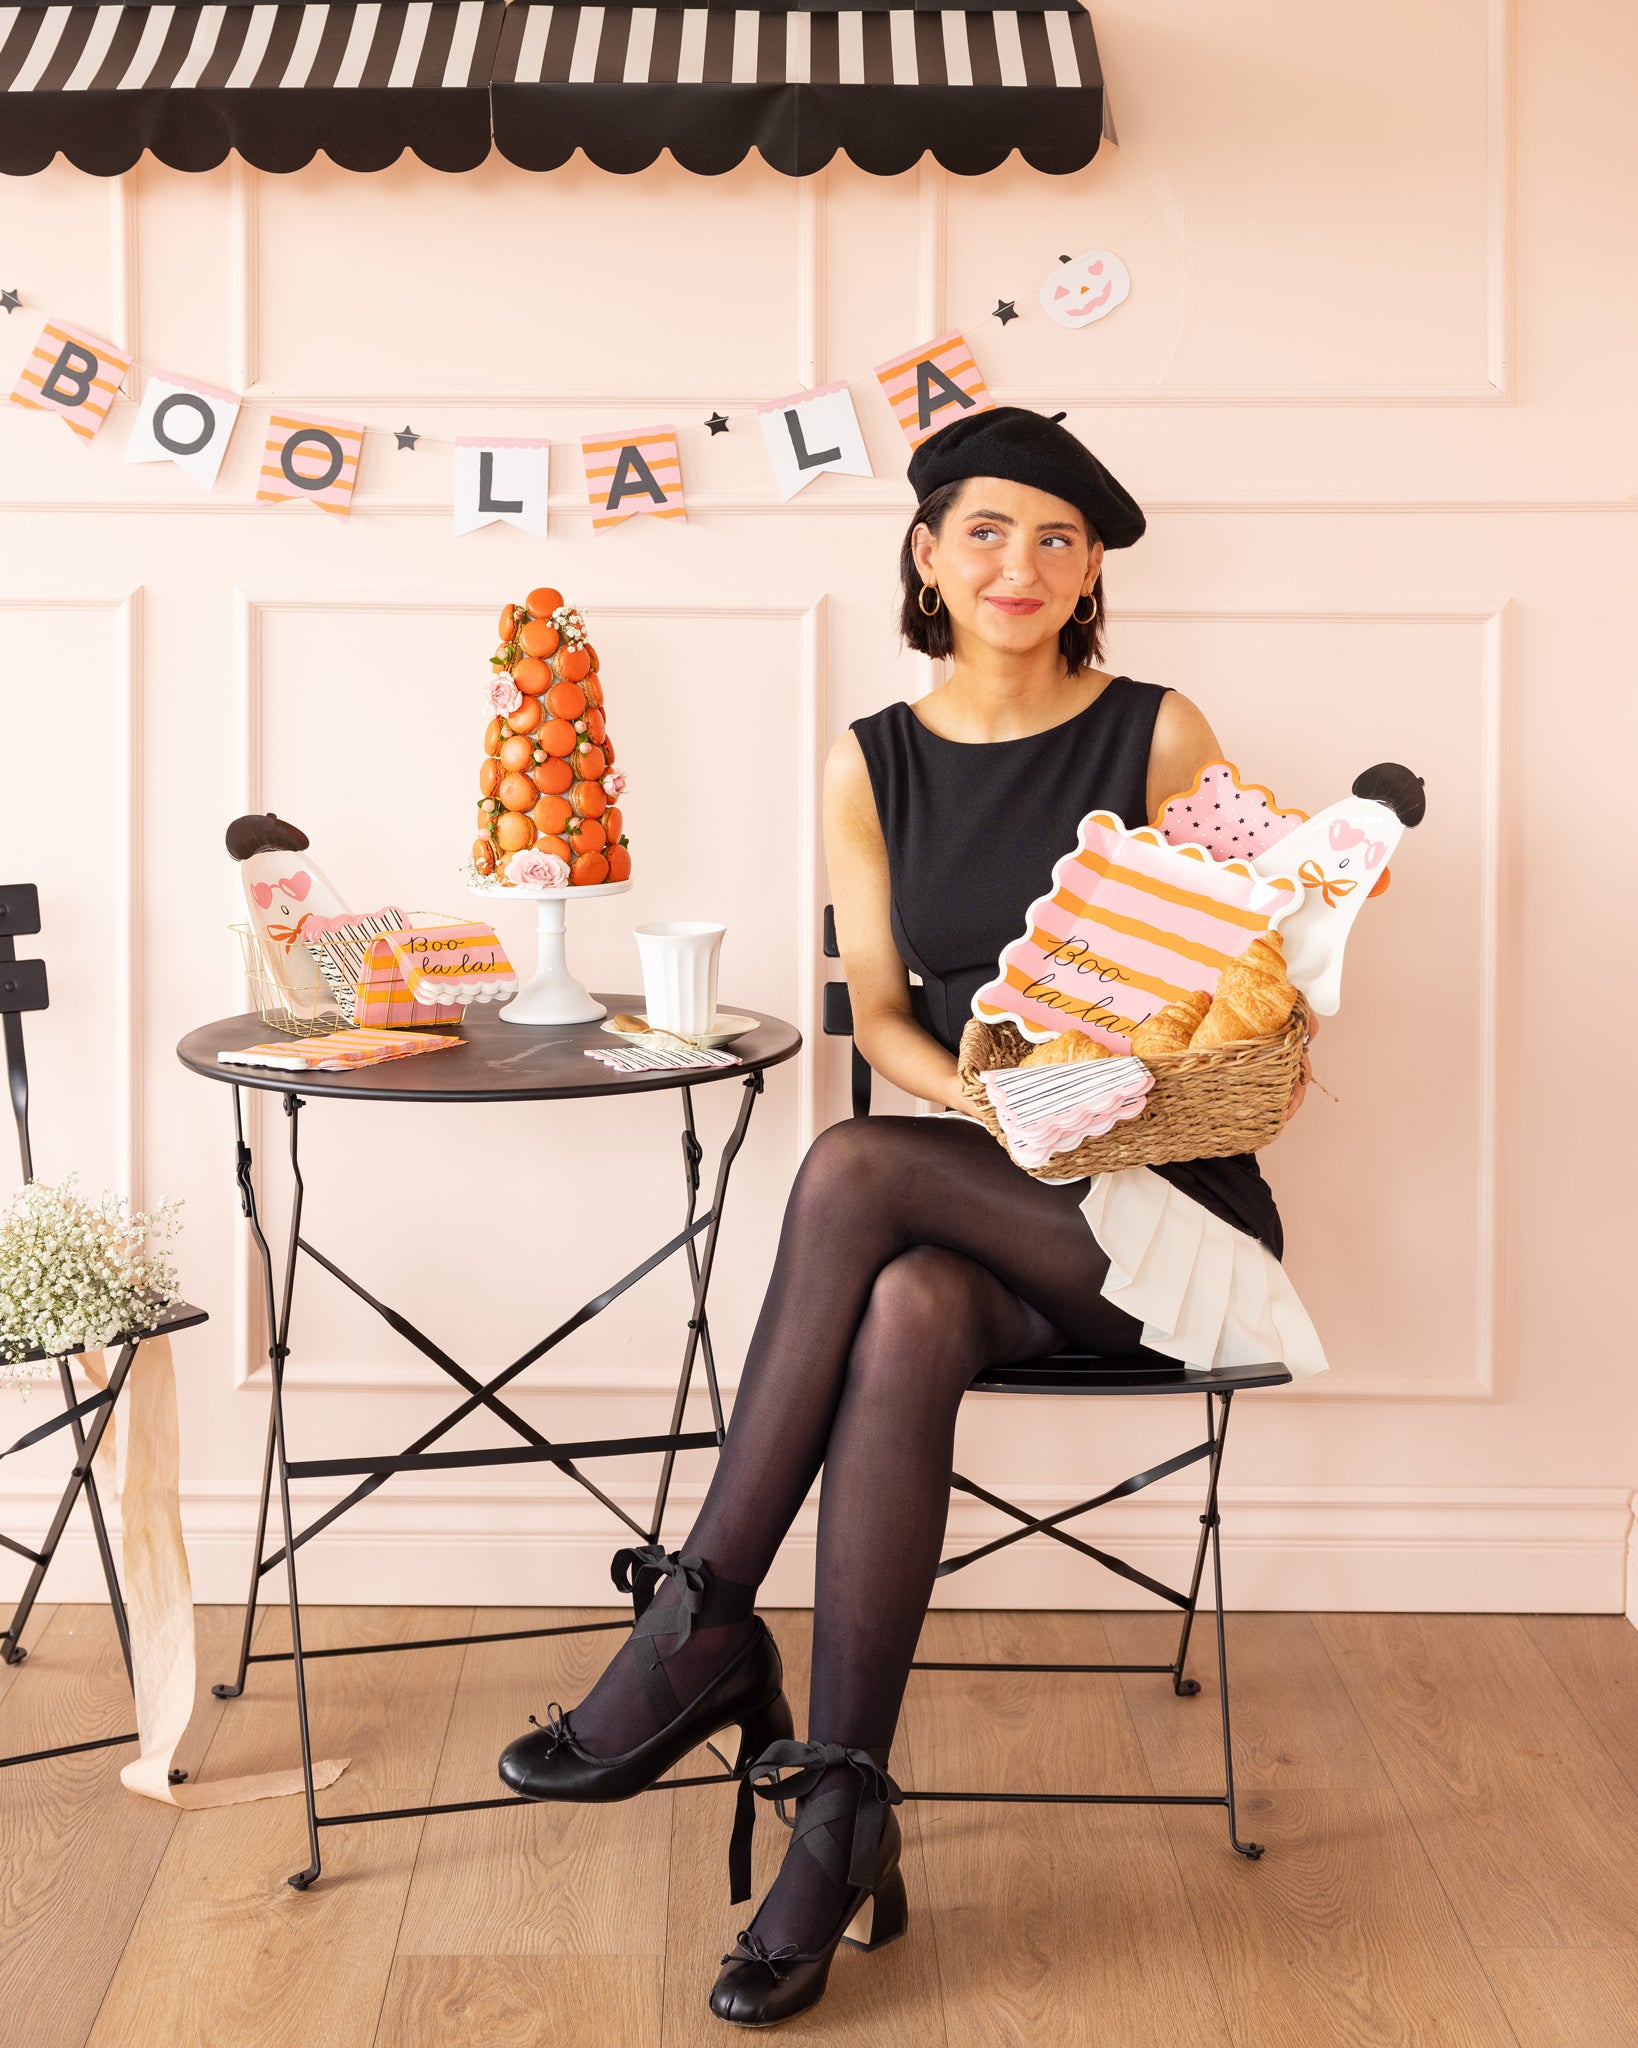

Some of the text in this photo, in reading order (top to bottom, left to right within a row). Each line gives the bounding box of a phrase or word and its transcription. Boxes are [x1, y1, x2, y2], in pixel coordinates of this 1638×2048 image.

[41, 340, 976, 513] BOO LA LA
[402, 936, 465, 954] Boo
[422, 951, 496, 975] la la!
[1043, 935, 1130, 983] Boo
[1022, 973, 1152, 1039] la la!
